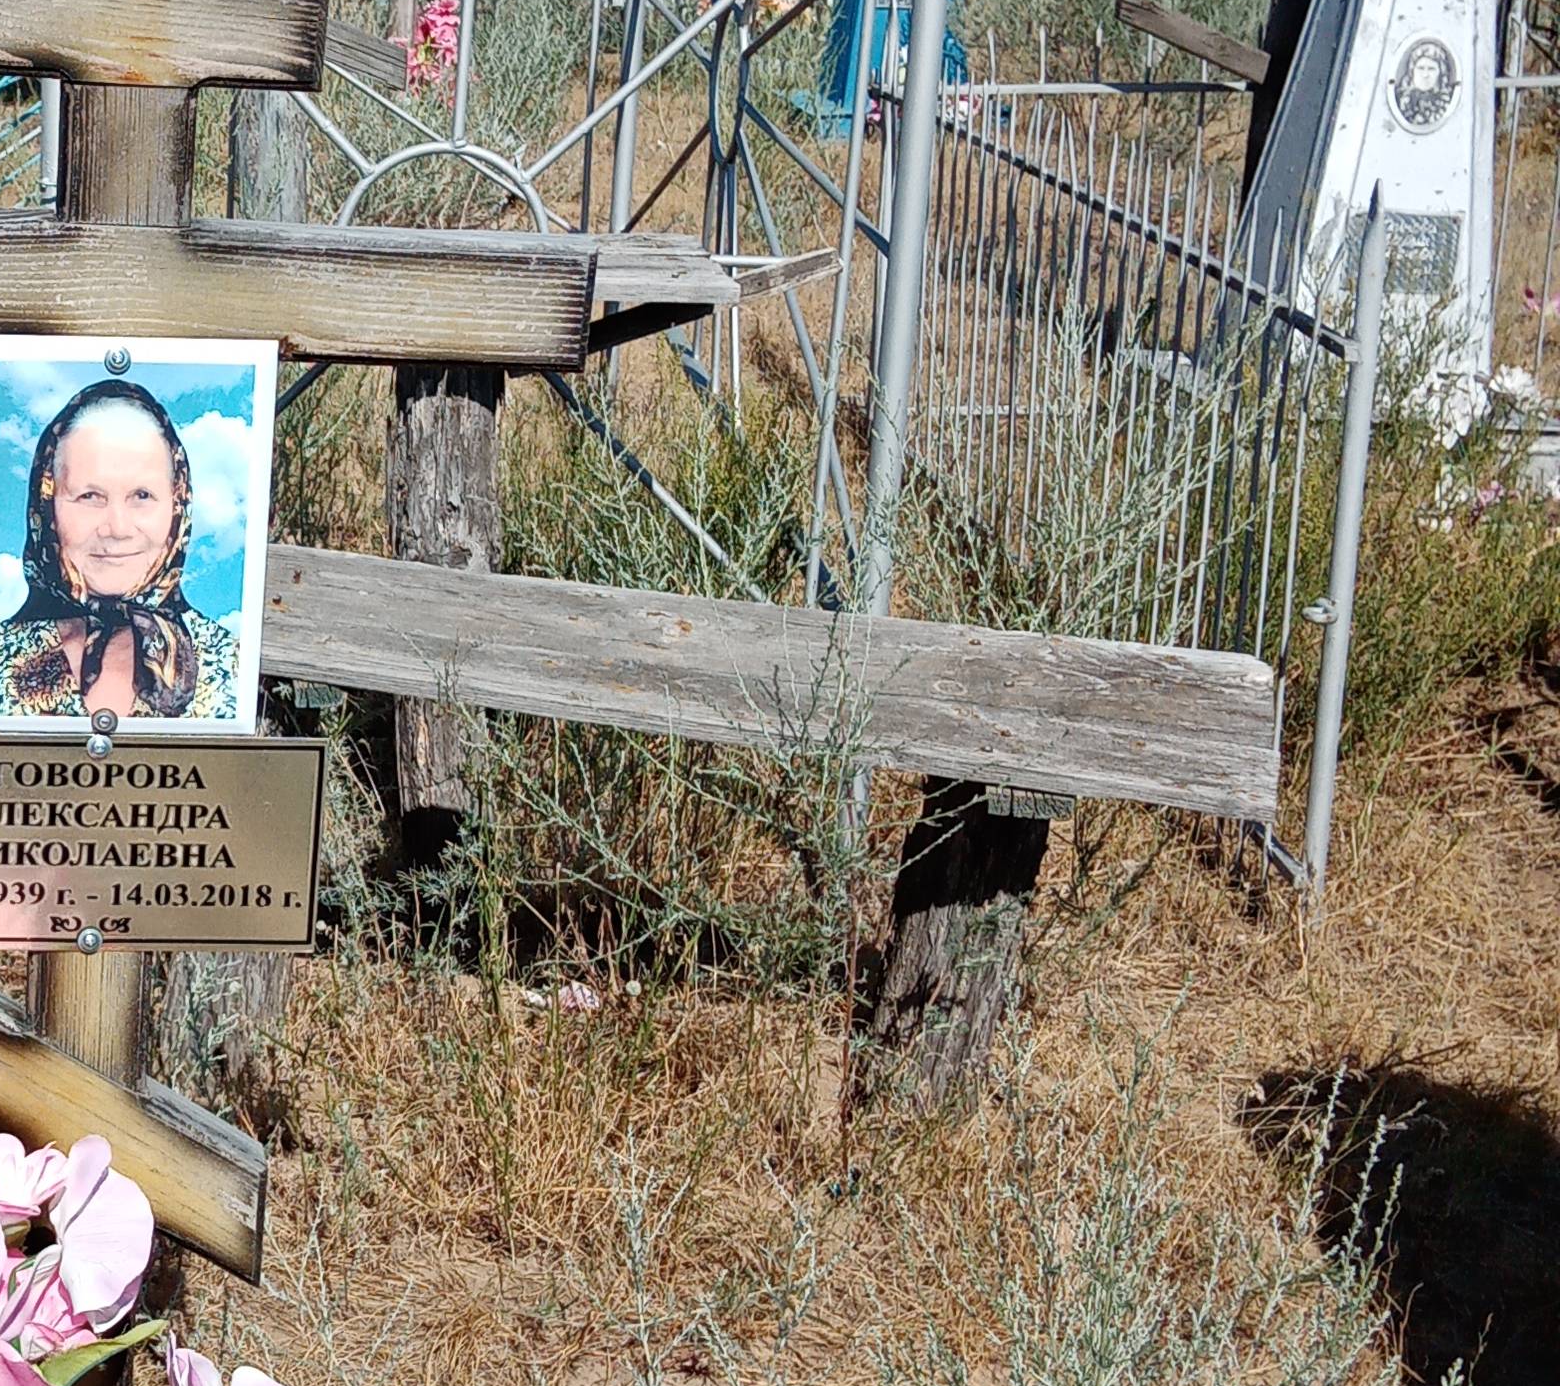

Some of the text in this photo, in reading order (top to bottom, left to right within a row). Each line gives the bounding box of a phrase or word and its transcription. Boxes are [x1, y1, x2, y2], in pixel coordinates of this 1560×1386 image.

[56, 889, 77, 906] г.
[110, 883, 273, 908] 14.03.2018
[282, 891, 303, 909] г.
